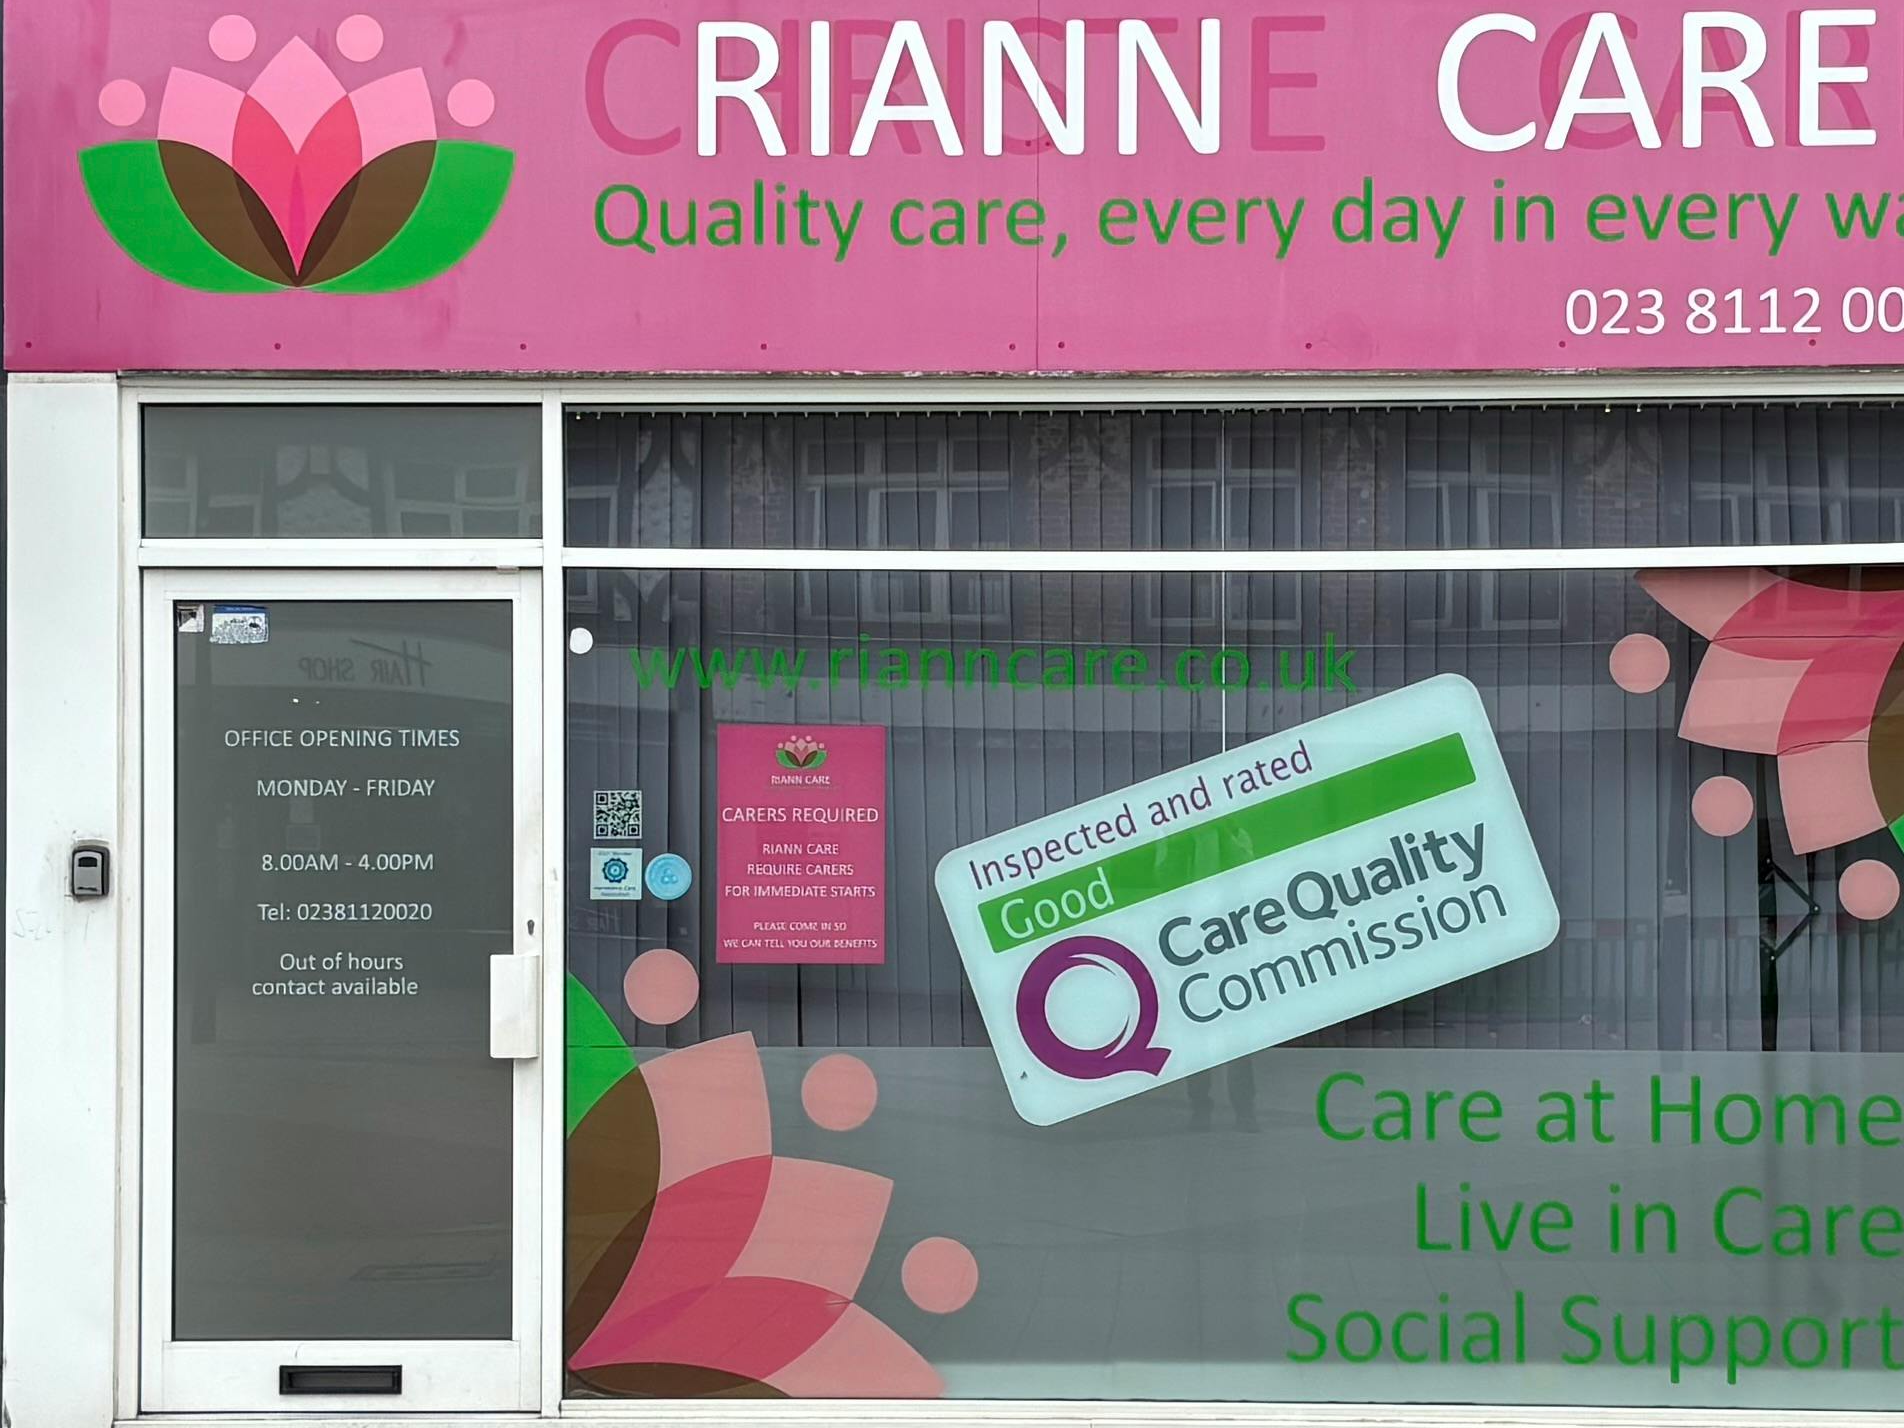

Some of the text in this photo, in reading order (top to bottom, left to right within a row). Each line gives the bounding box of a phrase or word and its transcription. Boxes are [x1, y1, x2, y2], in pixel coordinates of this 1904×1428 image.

[697, 9, 1877, 157] RIANN CARE
[595, 179, 864, 262] Quality
[890, 196, 1068, 258] care,
[1098, 197, 1305, 259] every
[1332, 177, 1465, 259] day
[1493, 178, 1555, 242] in
[1587, 184, 1799, 256] every
[1565, 288, 1665, 335] 023
[1685, 287, 1821, 334] 8112
[630, 632, 1359, 693] www.rianncare.co.uk
[224, 729, 460, 748] OFFICE OPENING TIMES
[257, 779, 347, 798] MONDAY
[366, 779, 435, 798] FRIDAY
[722, 807, 879, 825] CARERS REQUIRED
[968, 739, 1313, 890] Inspected and rated
[762, 843, 839, 856] RIANN CARE
[261, 854, 338, 871] 8.00AM
[358, 854, 434, 871] 4.00PM
[747, 863, 854, 877] REQUIRE CARERS
[725, 885, 876, 898] FOR IMMEDIATE STARTS
[258, 903, 433, 921] Tel: 02381120020
[1000, 867, 1115, 940] Good
[753, 922, 847, 931] PLEASE COME IN SO
[723, 939, 877, 948] WE CAN TELL YOU OUR BENEFITS
[1177, 881, 1507, 1025] Commission
[280, 951, 404, 972] Out of hours
[252, 977, 418, 996] contact available
[1315, 1072, 1903, 1147] Care at Home
[1416, 1181, 1904, 1258] Live in Care
[1285, 1290, 1904, 1385] Social Support
